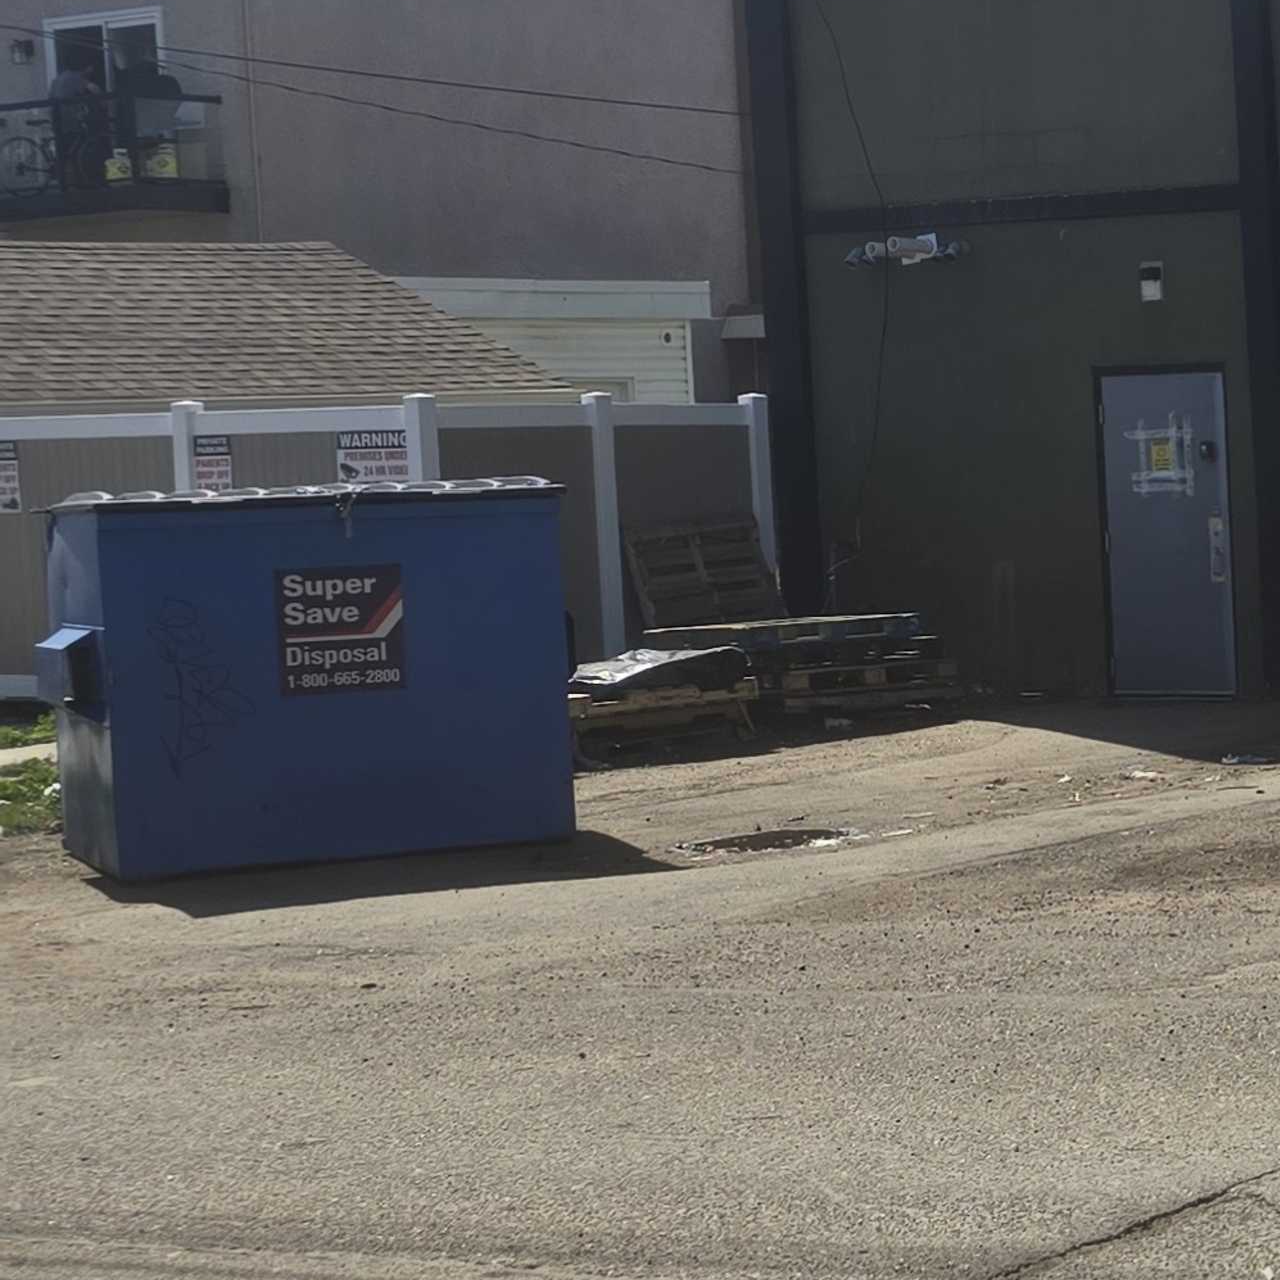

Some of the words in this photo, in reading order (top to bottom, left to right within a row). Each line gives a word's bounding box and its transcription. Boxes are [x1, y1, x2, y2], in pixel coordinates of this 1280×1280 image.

[282, 574, 376, 601] Super
[283, 602, 360, 626] Save
[285, 641, 386, 670] Disposal
[287, 668, 401, 689] 1-800-665-2800
